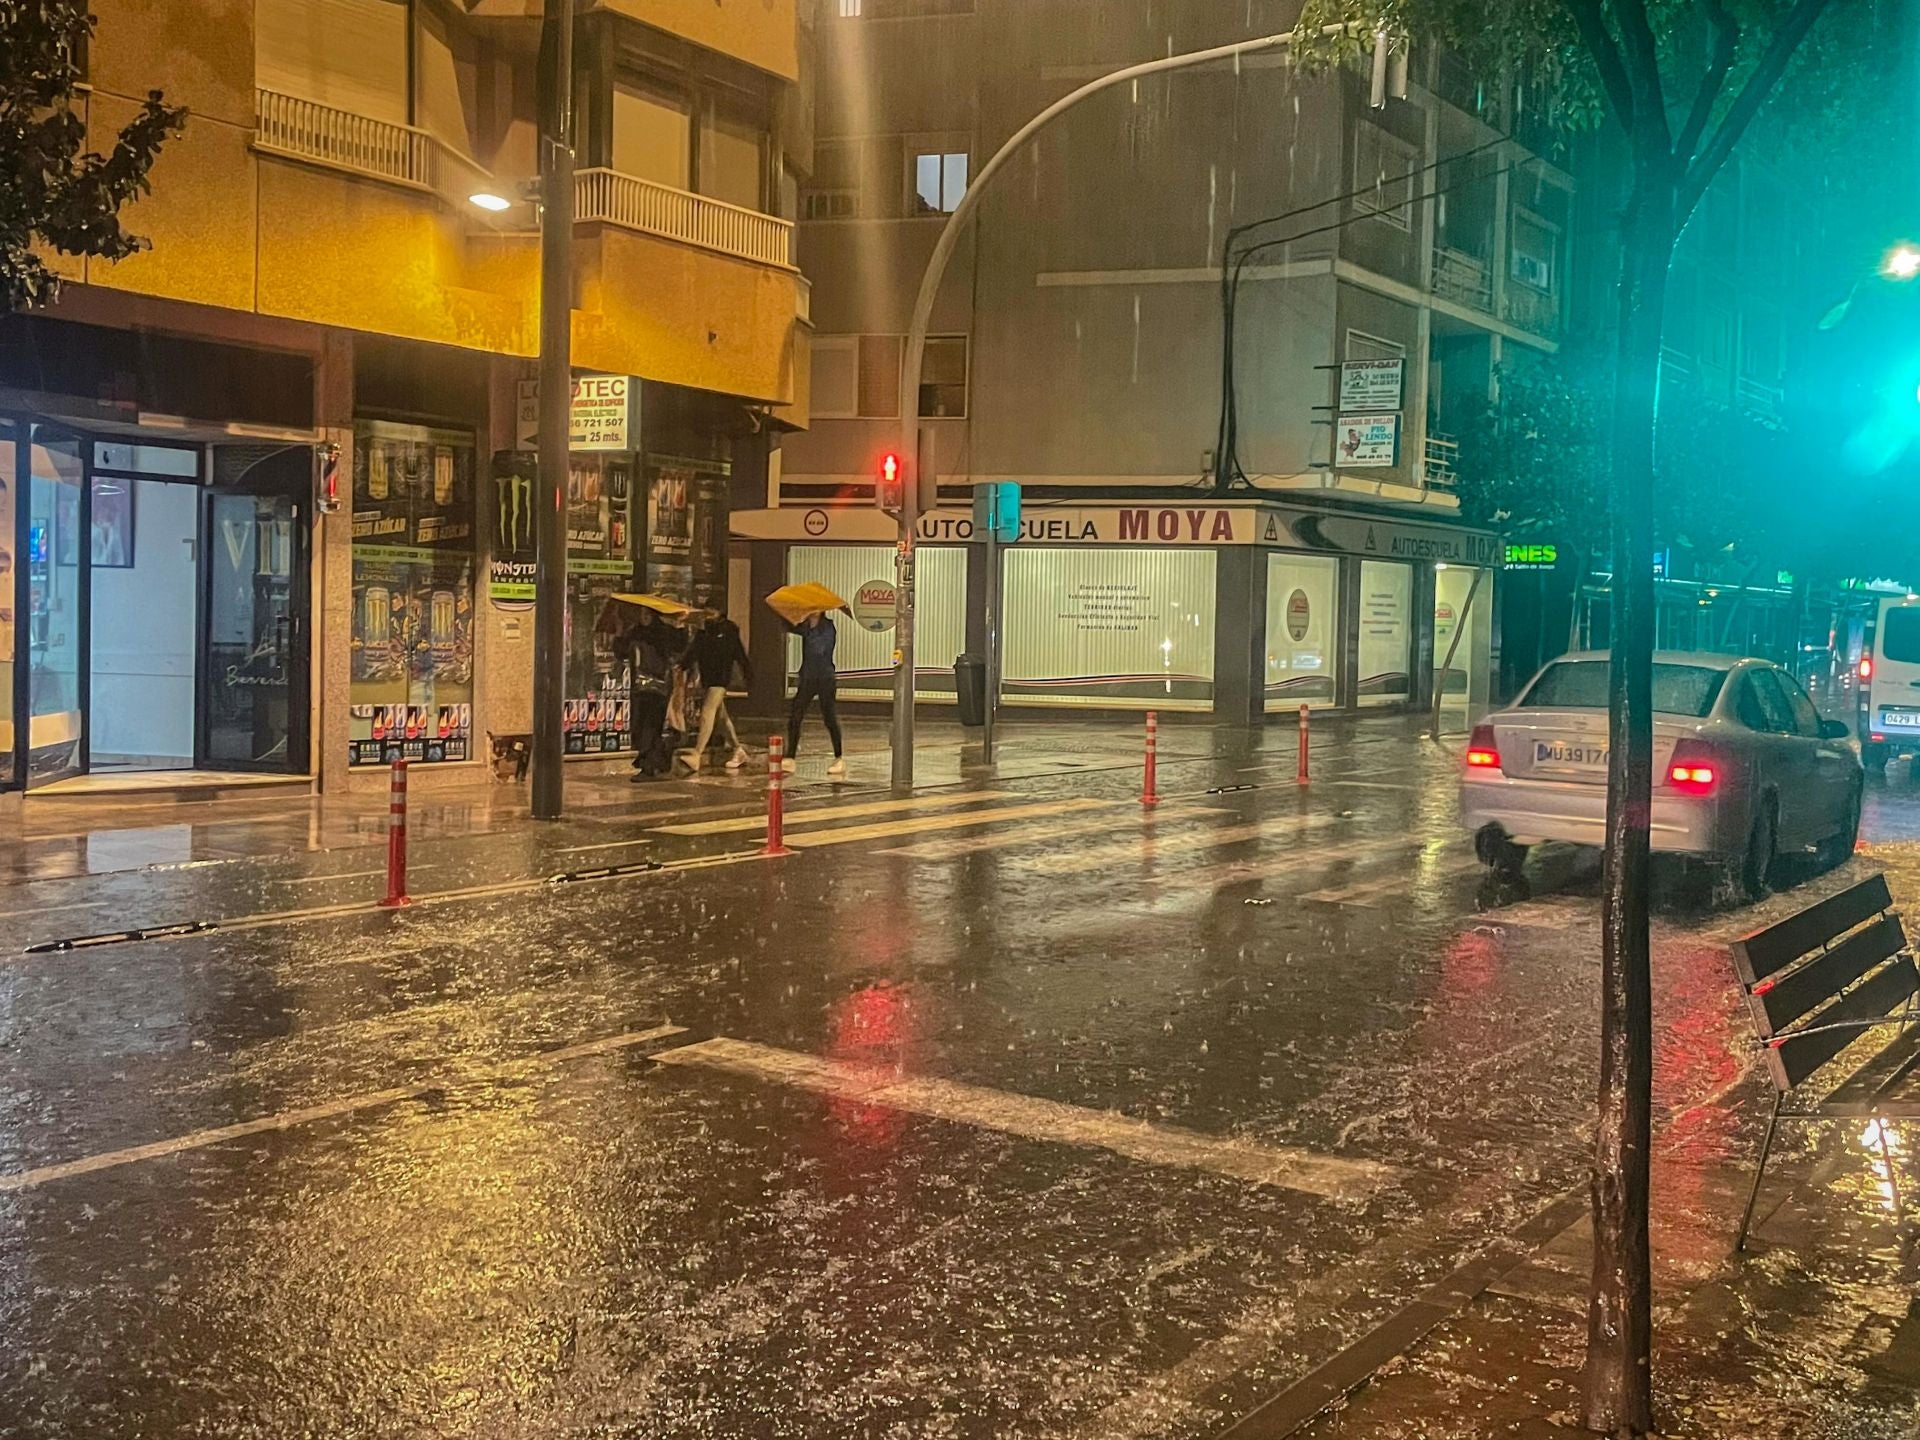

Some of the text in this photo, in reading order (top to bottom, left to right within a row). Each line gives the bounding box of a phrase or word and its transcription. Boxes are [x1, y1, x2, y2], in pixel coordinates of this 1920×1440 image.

[584, 418, 601, 428] 721
[605, 417, 623, 427] 507
[590, 431, 601, 442] 25
[1118, 509, 1234, 541] MOYA
[1391, 536, 1461, 560] AUTOESCUELA
[860, 589, 896, 604] MOYA
